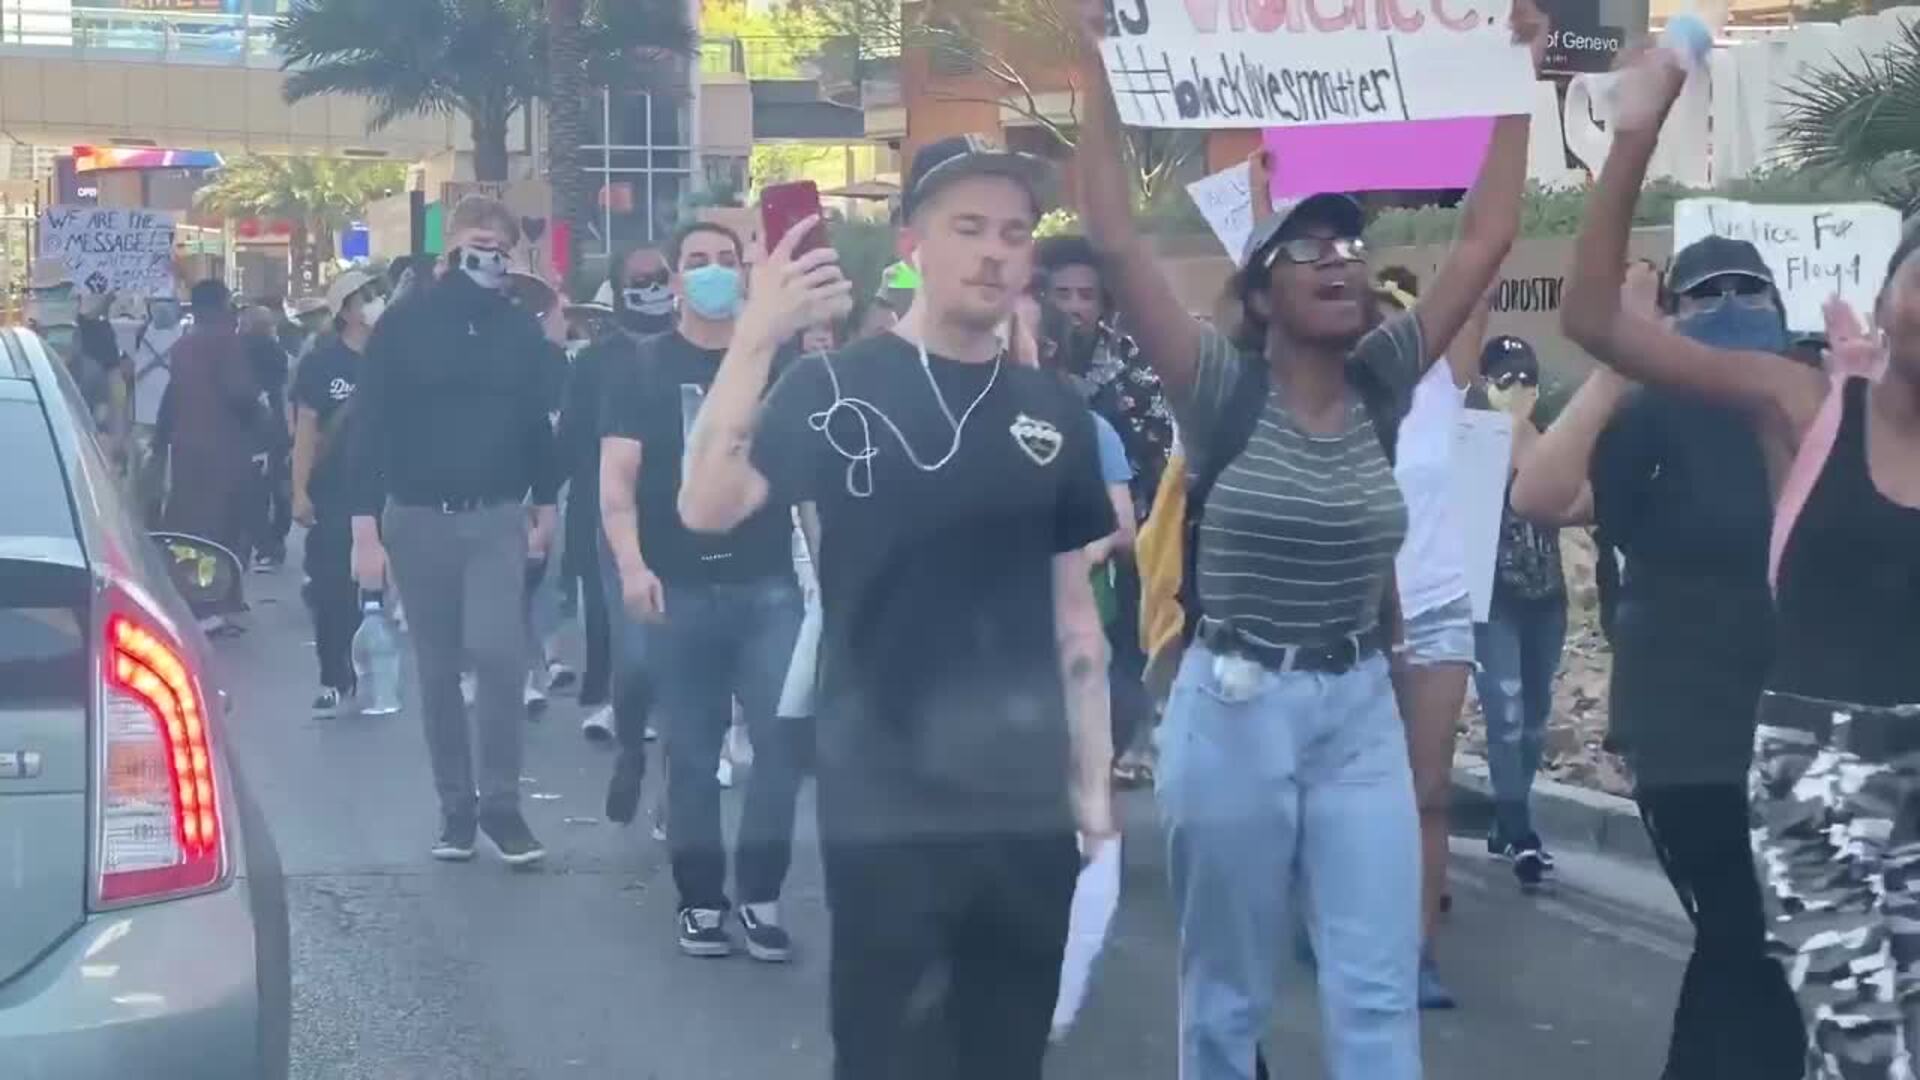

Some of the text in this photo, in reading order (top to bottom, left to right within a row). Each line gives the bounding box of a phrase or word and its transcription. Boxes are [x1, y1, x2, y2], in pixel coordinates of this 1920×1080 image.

[1563, 31, 1618, 52] Geneva
[47, 210, 80, 229] WE
[86, 211, 120, 229] ARE
[1488, 276, 1564, 312] NORDSTR
